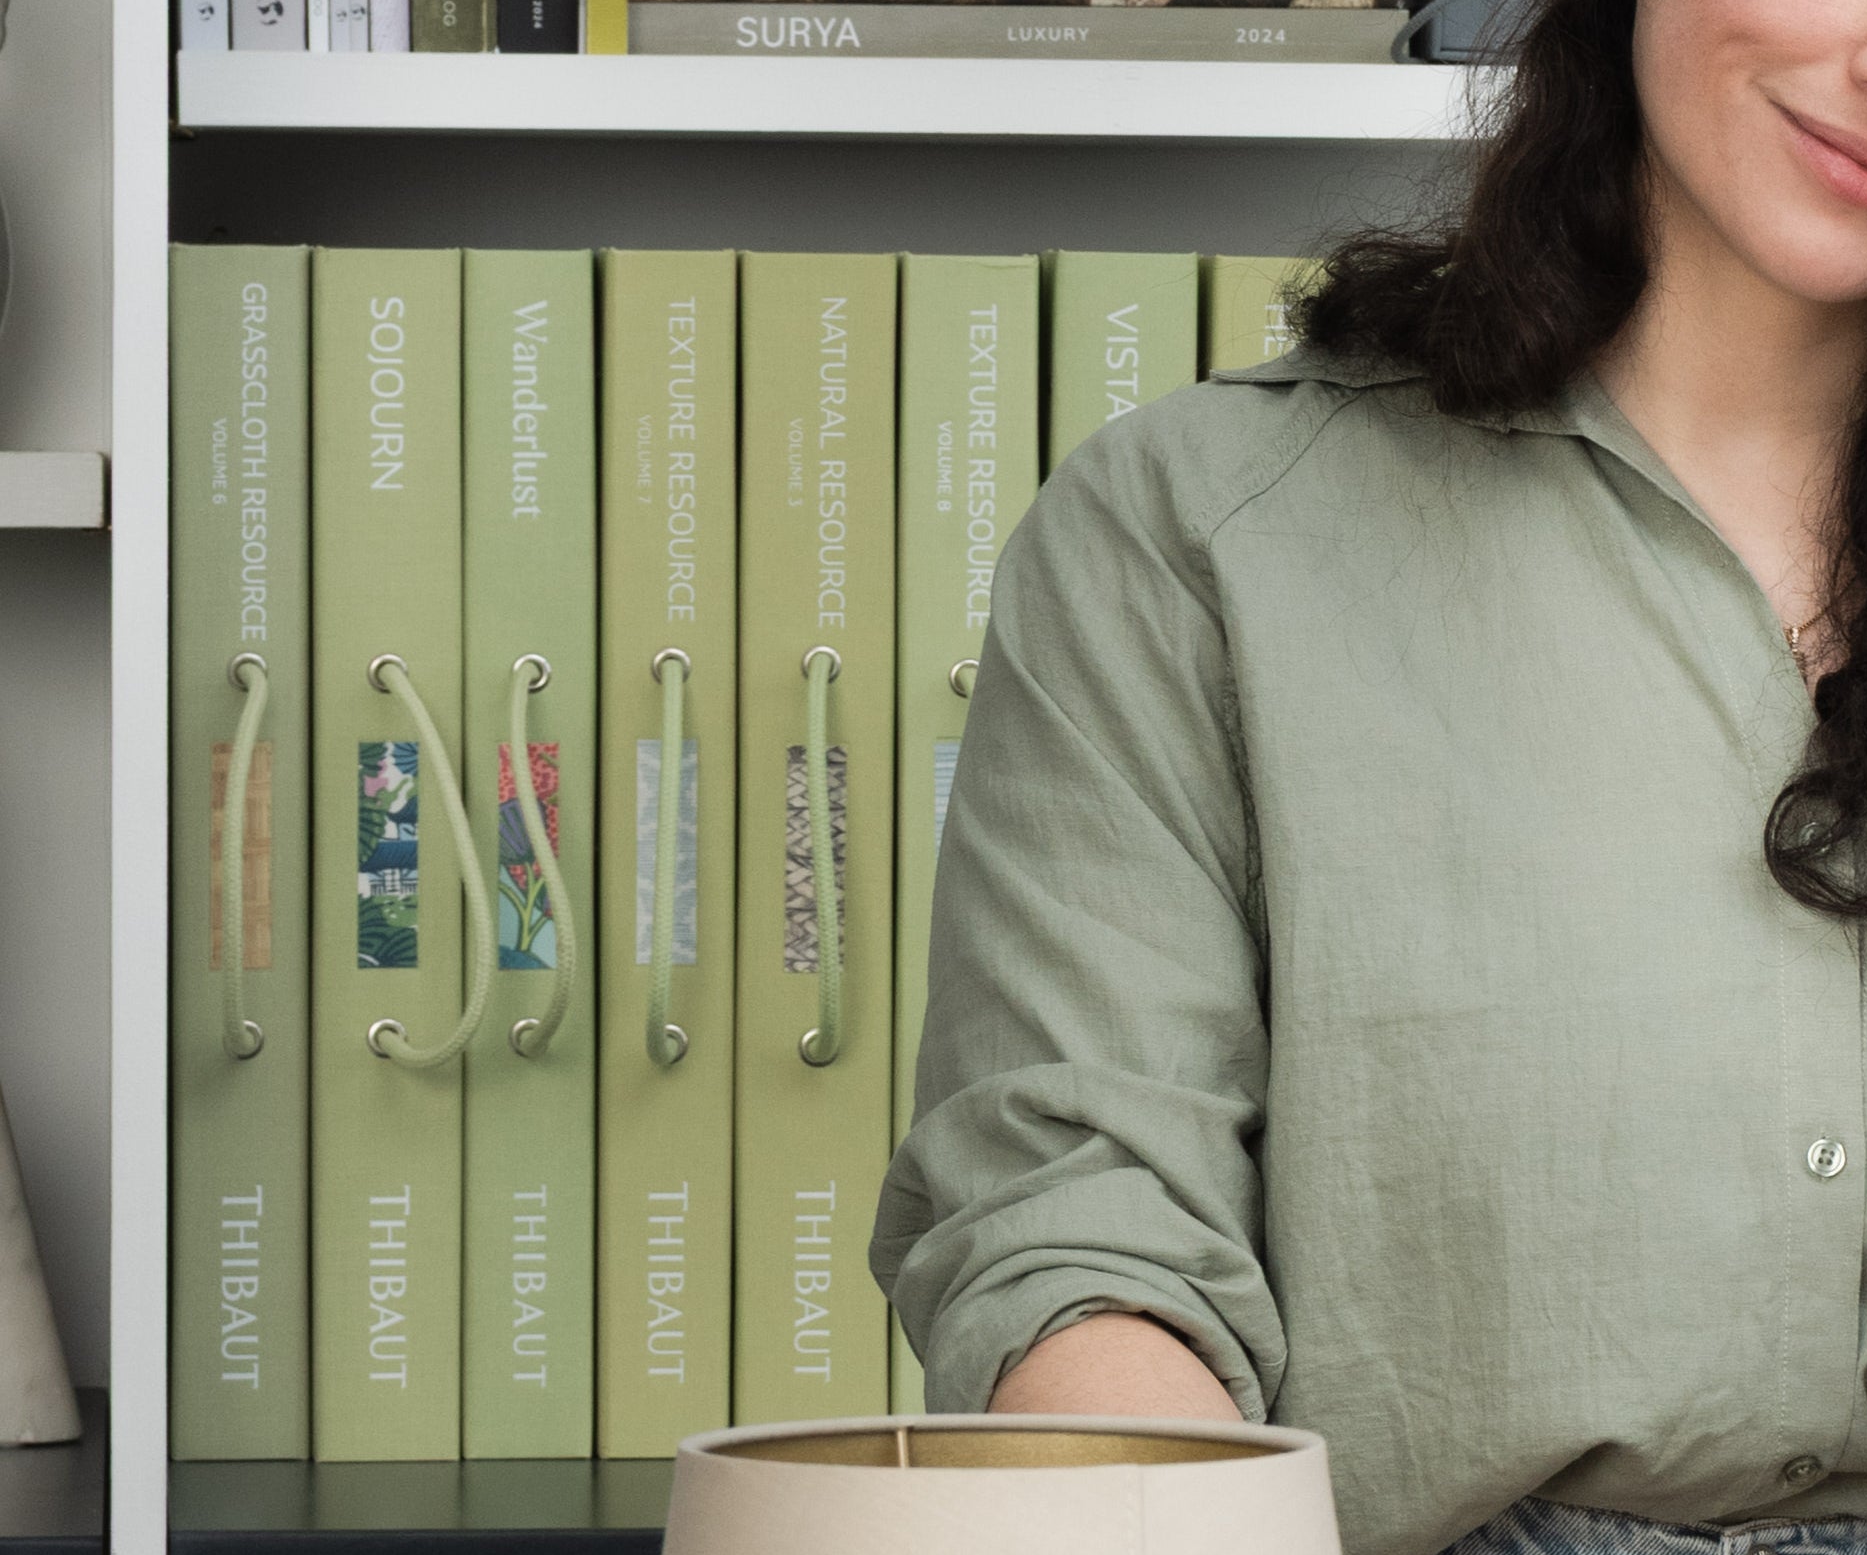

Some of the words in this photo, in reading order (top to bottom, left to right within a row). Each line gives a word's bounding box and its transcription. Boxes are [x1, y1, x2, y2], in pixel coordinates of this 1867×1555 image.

[532, 0, 544, 30] 2024
[736, 15, 861, 48] SURYA
[1007, 25, 1090, 42] LUXURY
[1236, 27, 1287, 43] 2024
[241, 282, 268, 479] GRASSCLOTH
[366, 296, 405, 490] SOJOURN
[511, 299, 548, 519] Wanderlust
[667, 296, 697, 441] TEXTURE
[819, 296, 848, 450] NATURAL
[967, 303, 998, 450] TEXTURE
[212, 416, 228, 489] VOLUME
[212, 494, 227, 506] 6
[637, 413, 652, 488] VOLUME
[787, 417, 803, 489] VOLUME
[936, 420, 953, 495] VOLUME
[241, 487, 268, 642] RESOURCE
[667, 451, 696, 624] RESOURCE
[817, 459, 847, 629] RESOURCE
[965, 458, 996, 630] RESOURCE
[219, 1184, 263, 1391] THIBAUT
[368, 1184, 411, 1391] THIBAUT
[512, 1183, 548, 1389] THIBAUT
[646, 1180, 690, 1386] THIBAUT
[794, 1179, 836, 1384] THIBAUT
